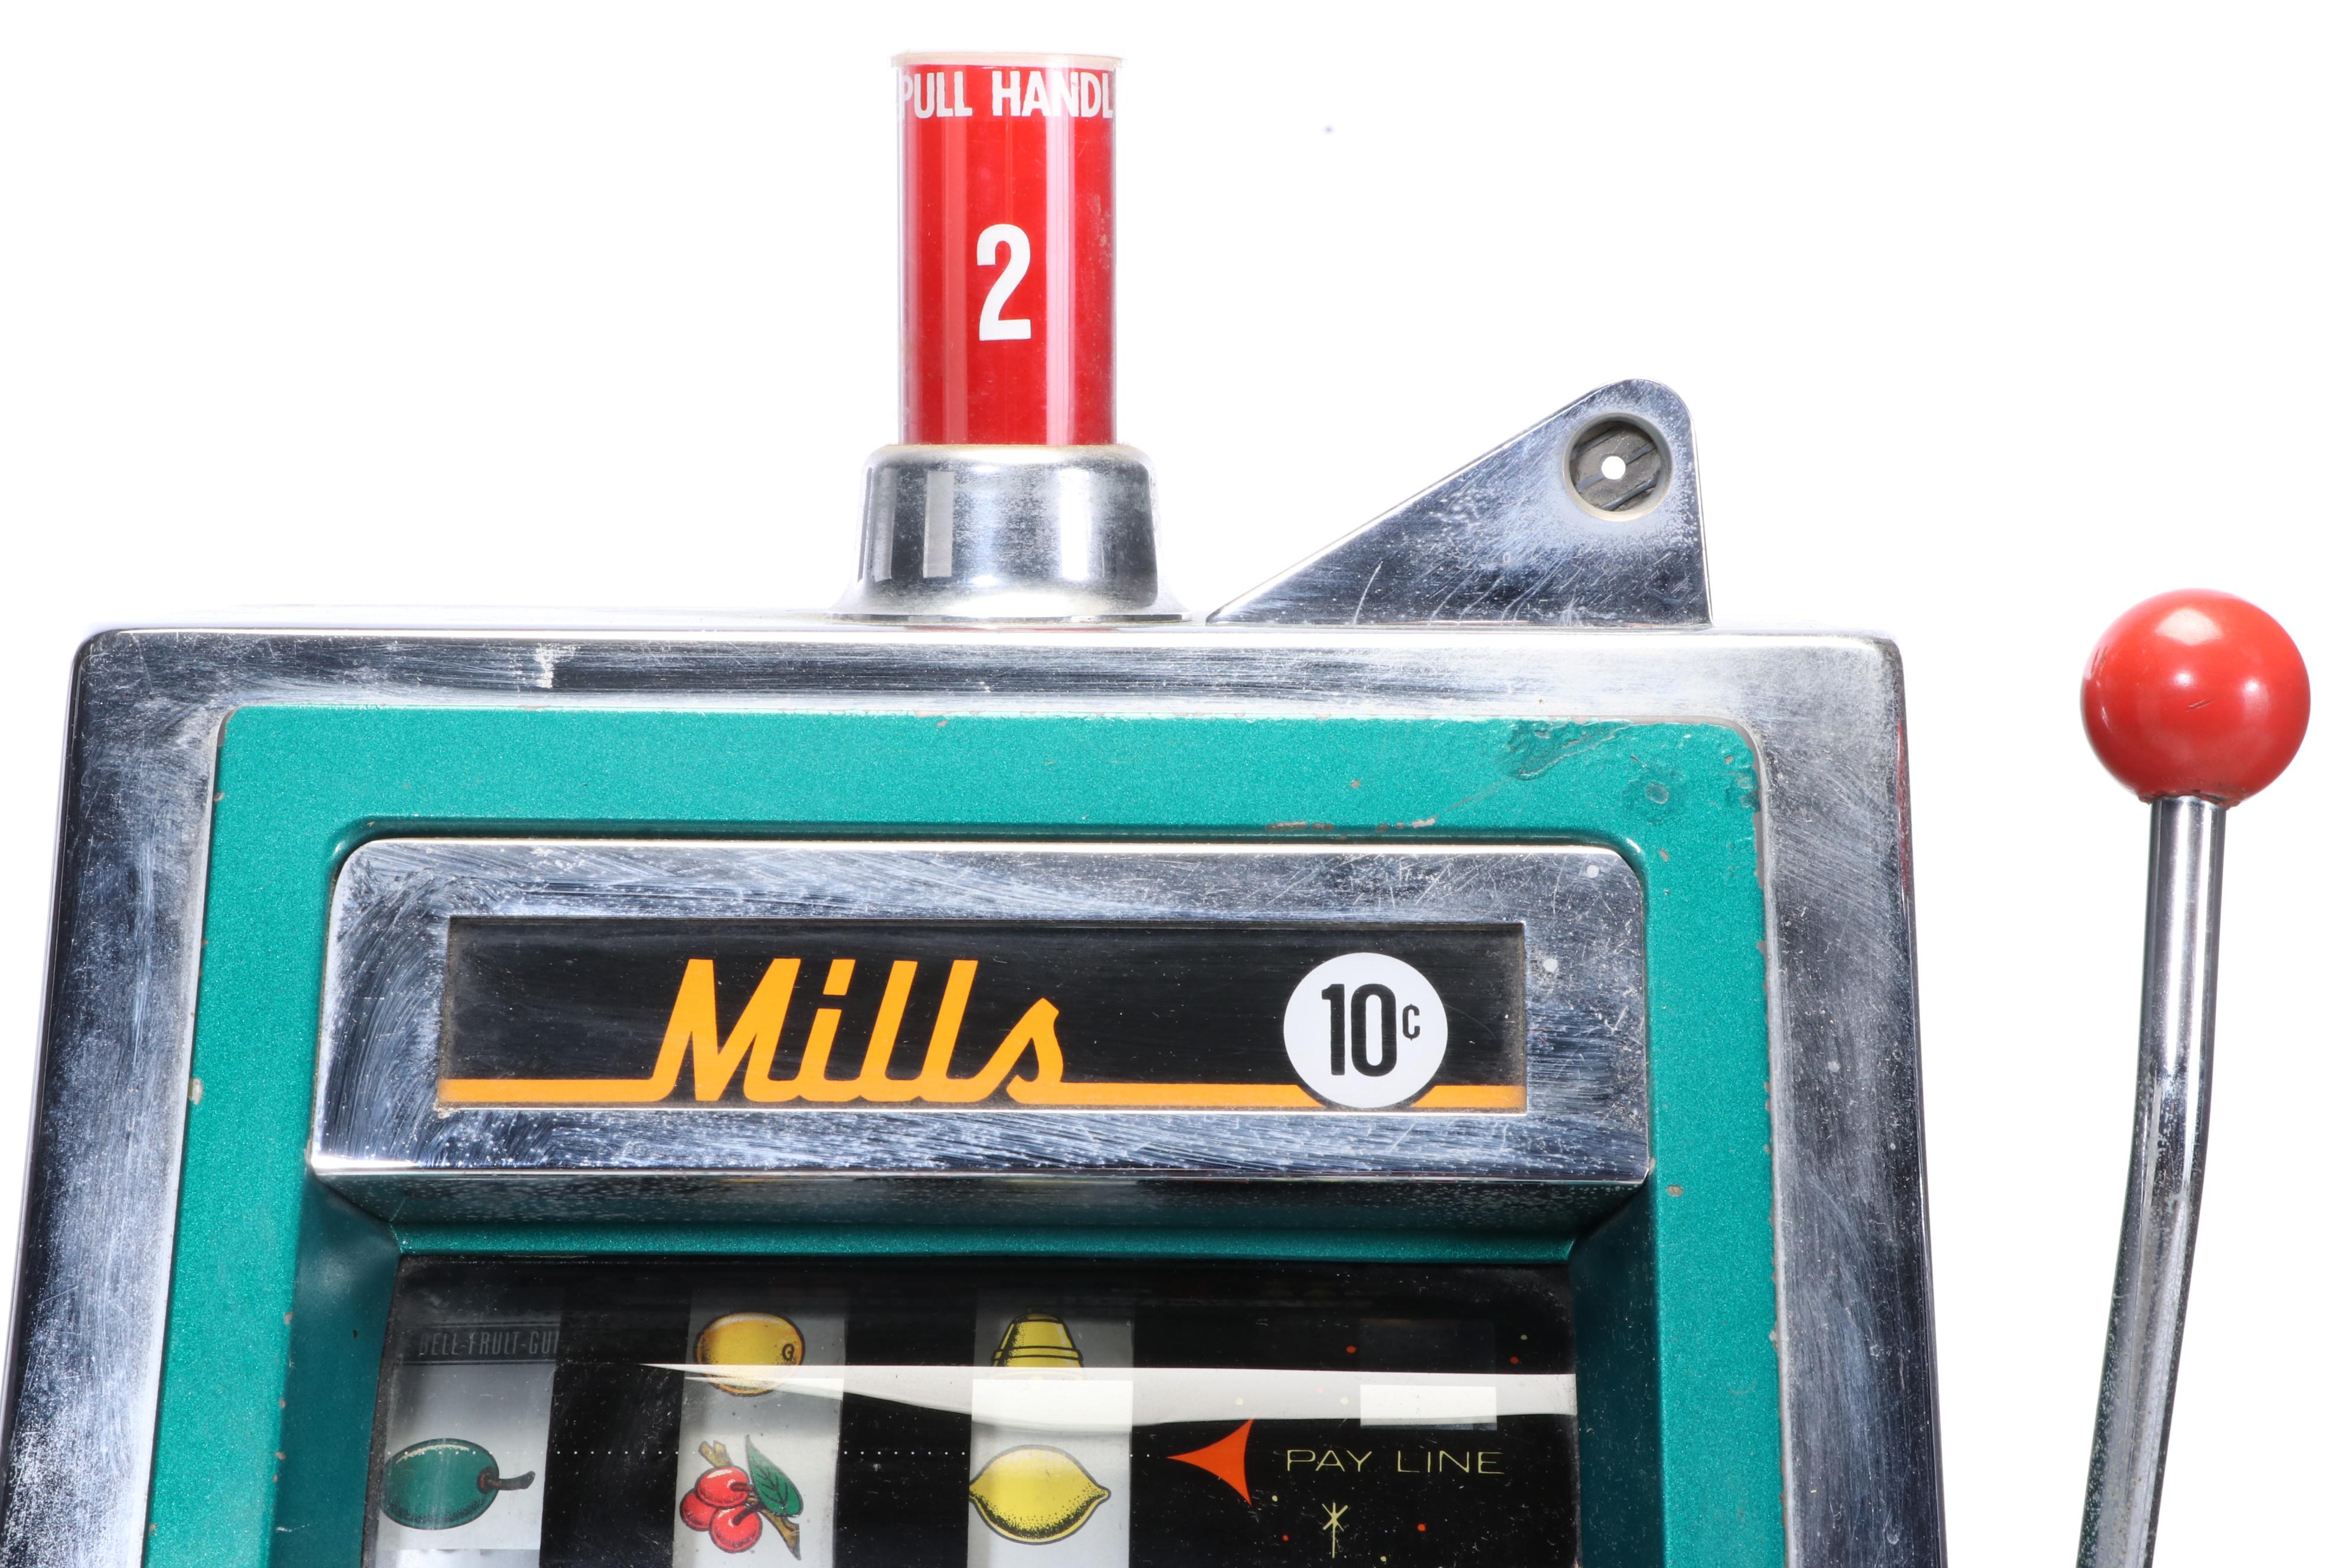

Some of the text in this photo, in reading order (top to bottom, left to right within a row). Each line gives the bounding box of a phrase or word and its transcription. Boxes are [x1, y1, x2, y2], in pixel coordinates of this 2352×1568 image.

[897, 71, 973, 119] PULL
[976, 223, 1031, 341] 2
[651, 958, 1064, 1104] Mills
[1286, 1449, 1505, 1474] PAY LINE
